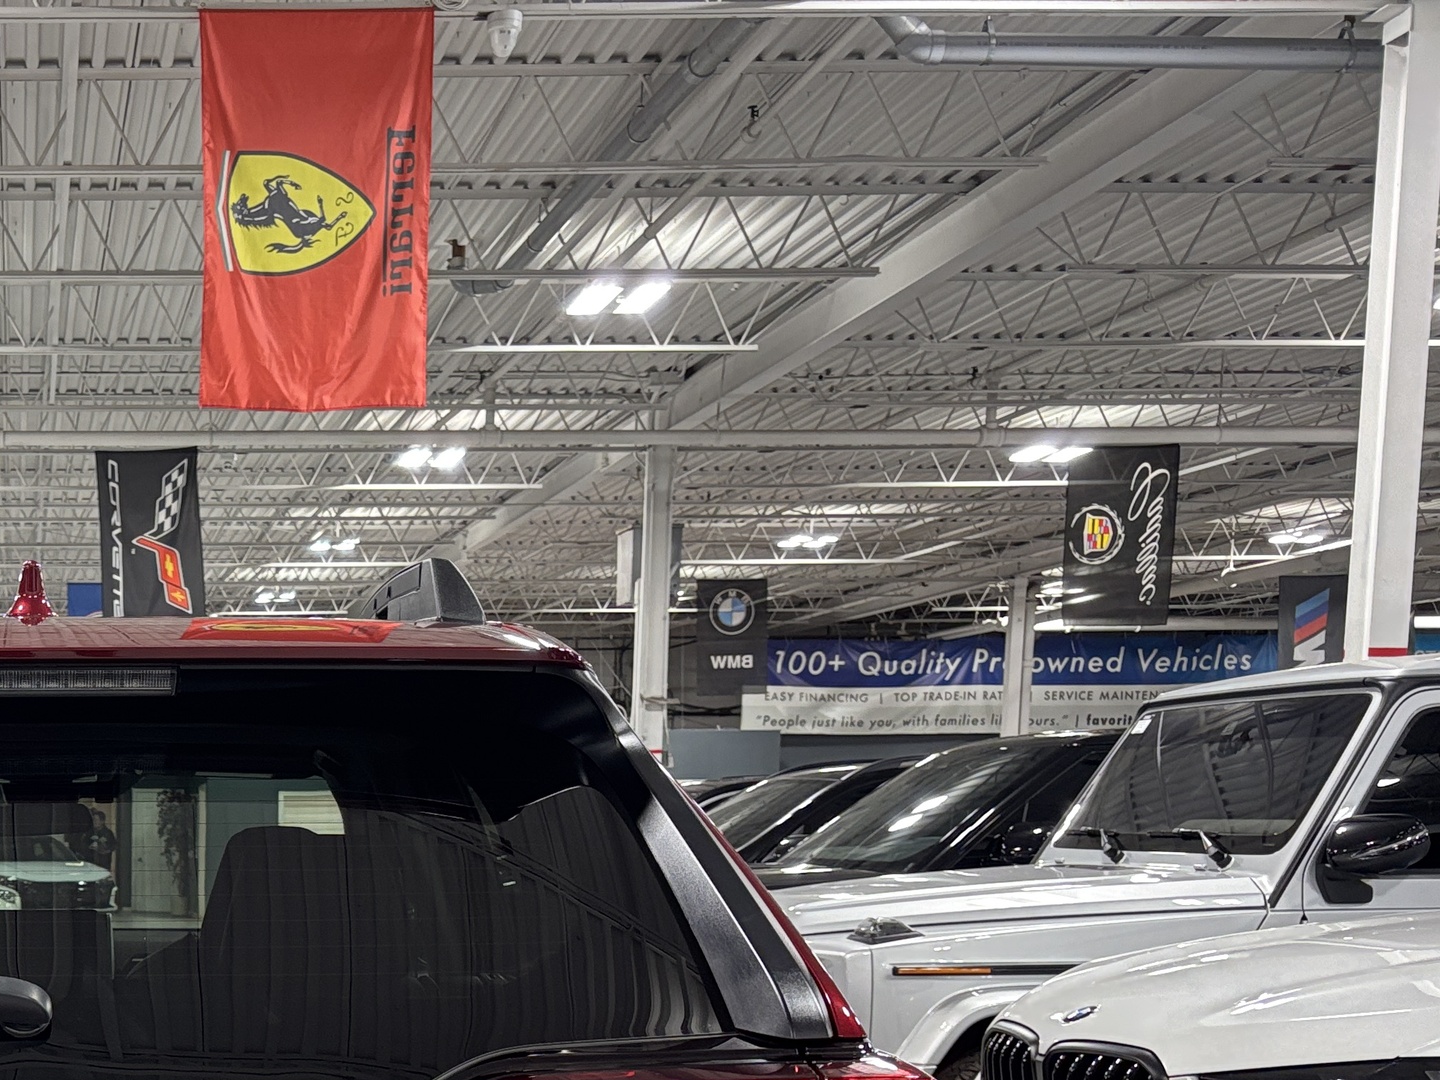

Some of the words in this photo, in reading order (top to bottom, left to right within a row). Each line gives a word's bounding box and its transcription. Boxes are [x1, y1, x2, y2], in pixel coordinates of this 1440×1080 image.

[108, 459, 125, 617] CORVETTE
[774, 650, 846, 676] 100+
[858, 649, 962, 681] Quality
[1137, 643, 1252, 673] Vehicles
[764, 691, 795, 702] EASY
[798, 692, 869, 703] FINANCING
[894, 692, 918, 702] TOP
[923, 690, 977, 702] TRADE-IN
[983, 690, 1003, 701] RAT
[1043, 690, 1093, 701] SERVICE
[812, 713, 836, 730] just
[841, 714, 864, 728] like
[868, 718, 896, 730] you,
[902, 714, 929, 727] with
[934, 713, 986, 727] families
[1086, 712, 1133, 726] favorit
